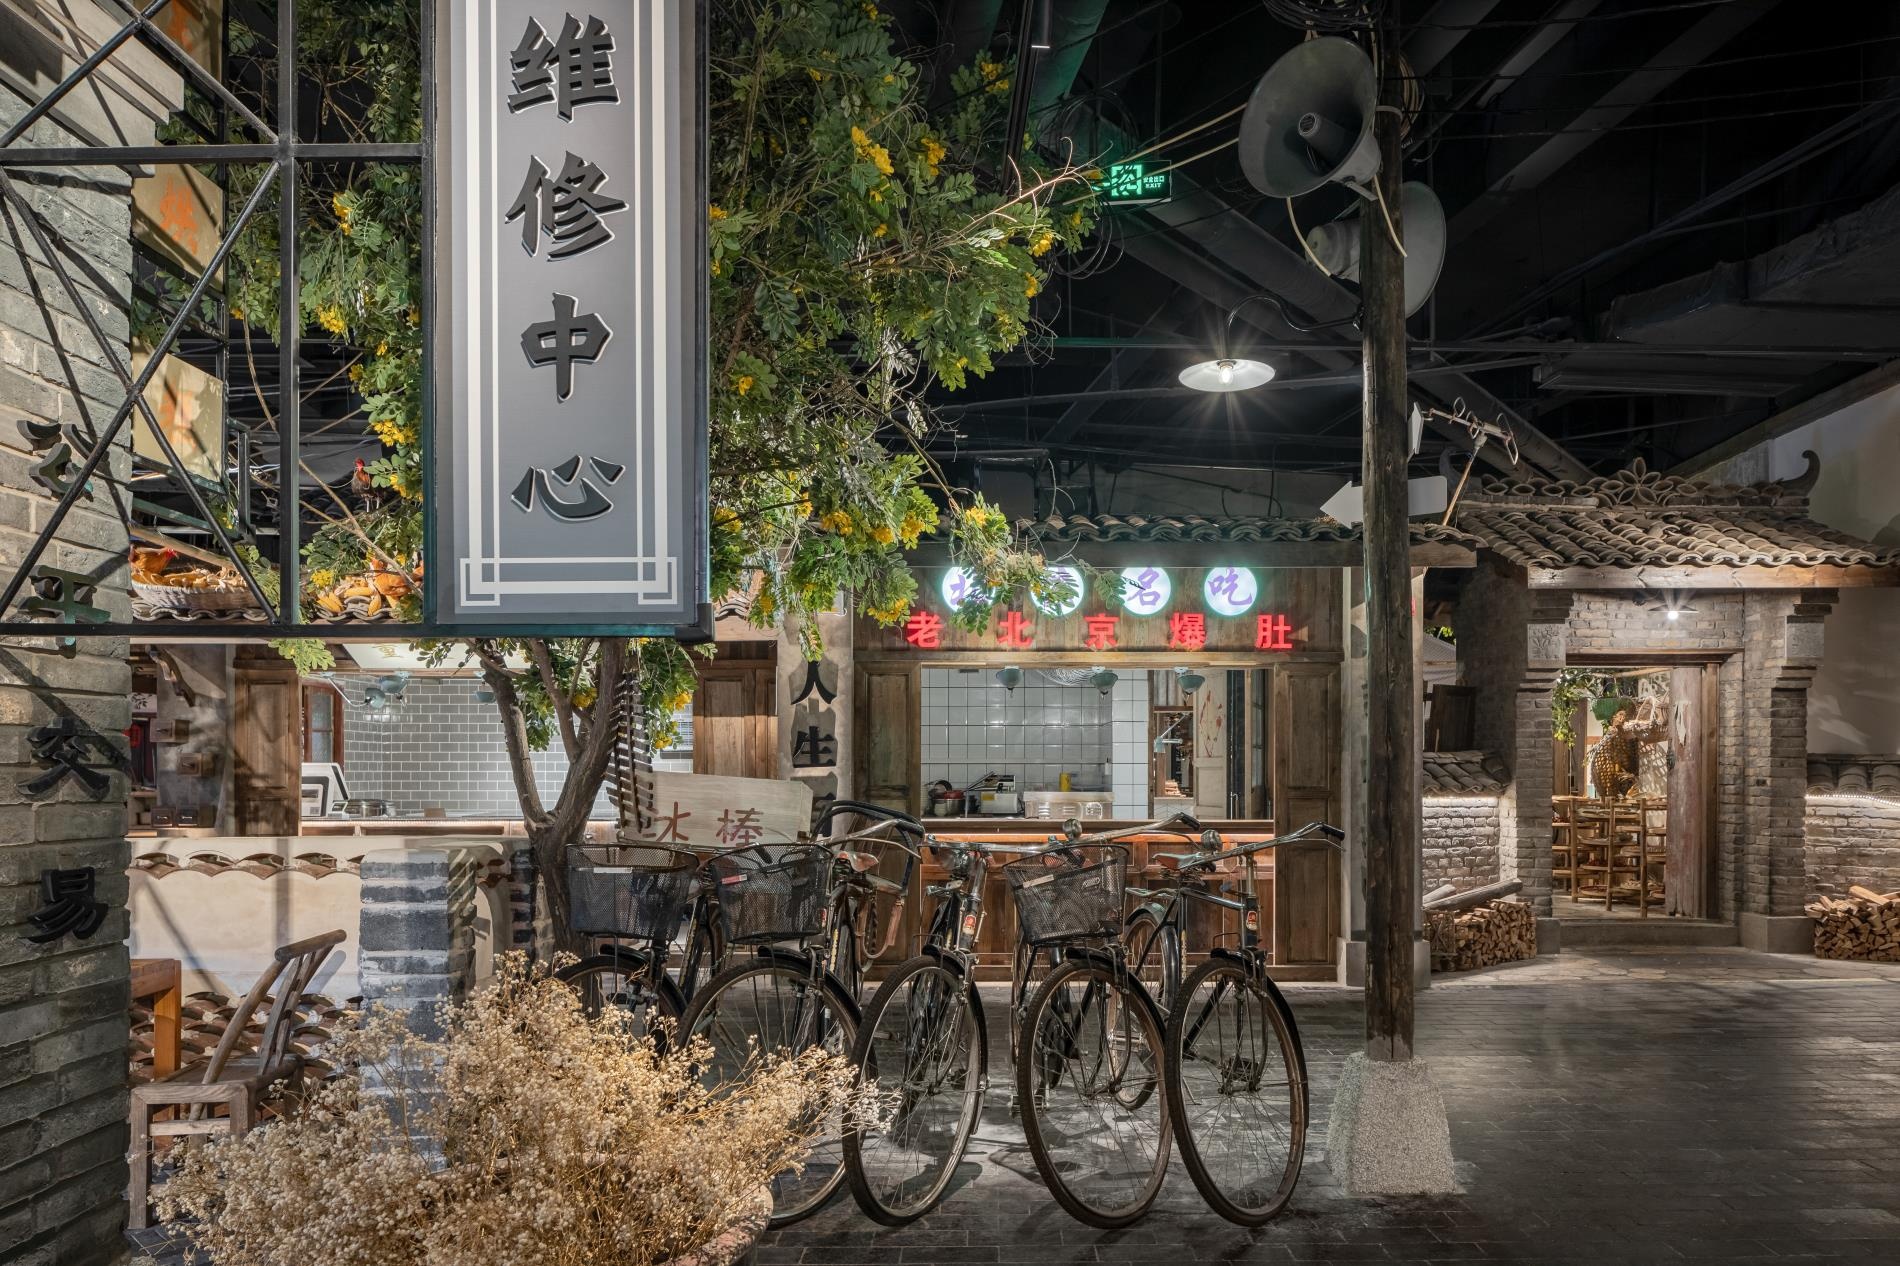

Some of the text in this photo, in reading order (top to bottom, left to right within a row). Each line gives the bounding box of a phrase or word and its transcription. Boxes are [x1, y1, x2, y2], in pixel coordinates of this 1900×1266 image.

[505, 12, 629, 522] 维修中心
[907, 611, 1293, 650] 老北京爆肚
